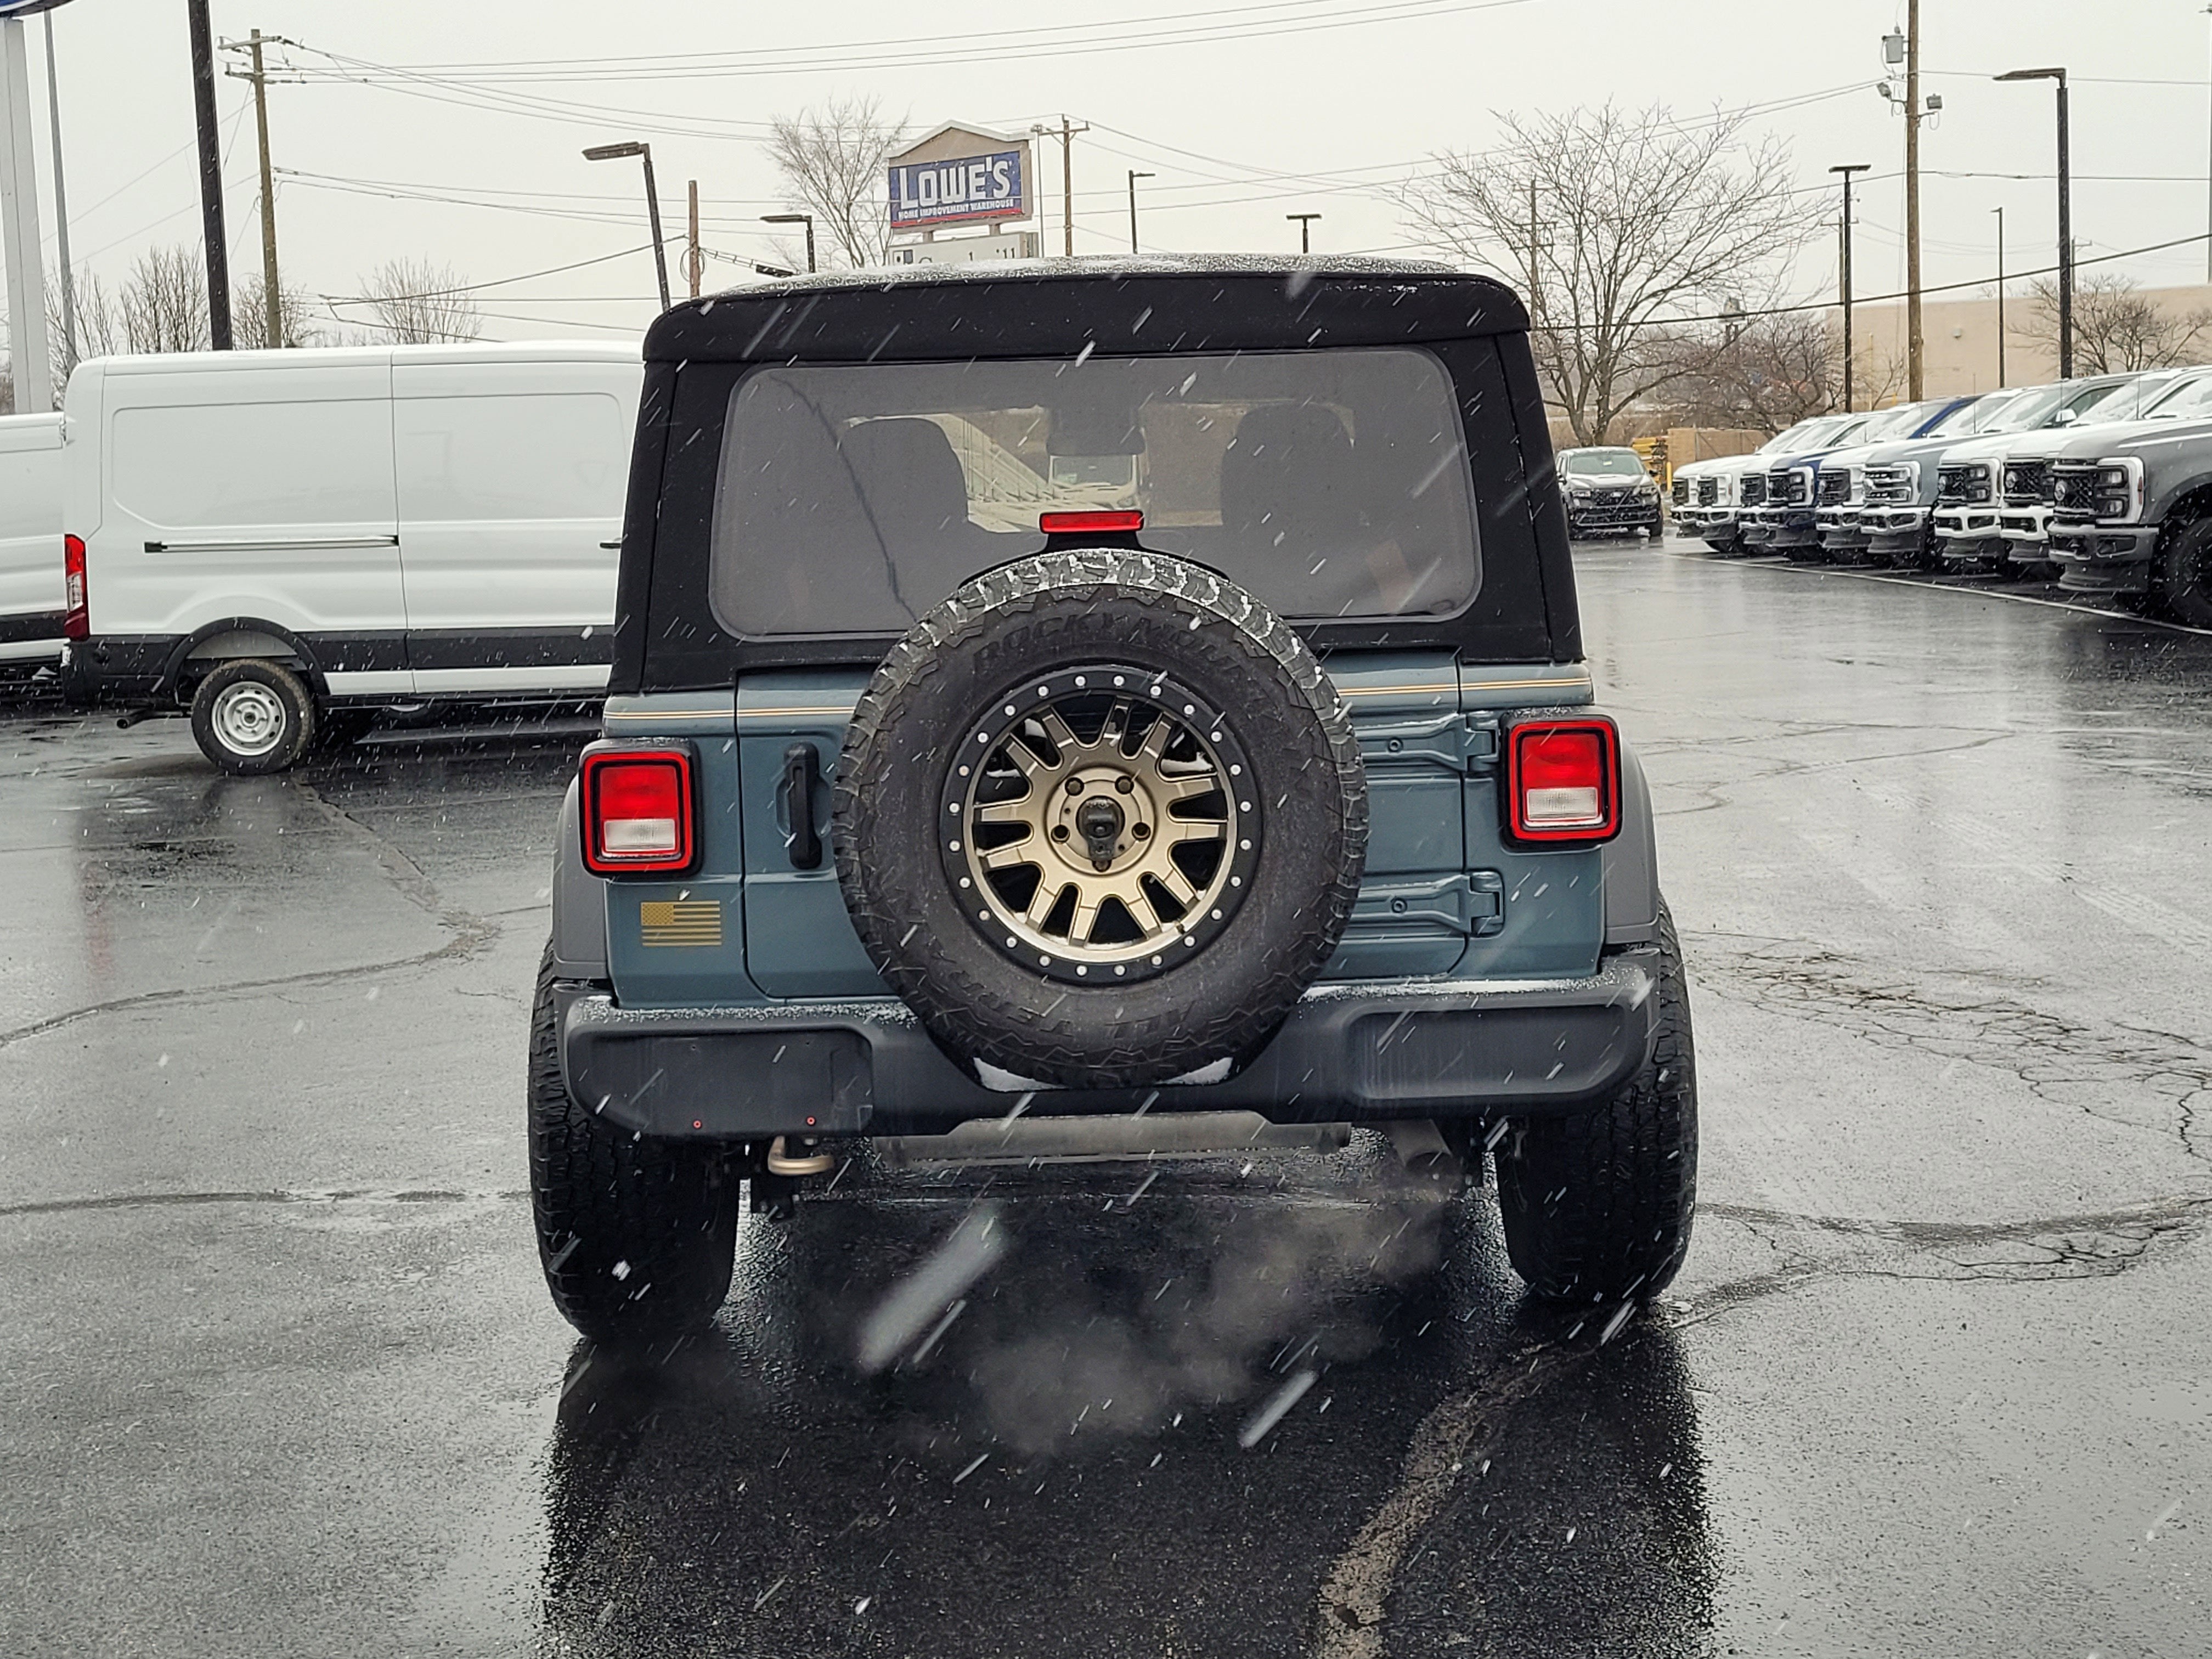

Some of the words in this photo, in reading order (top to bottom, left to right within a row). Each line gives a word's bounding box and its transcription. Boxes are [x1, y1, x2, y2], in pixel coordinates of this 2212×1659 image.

[898, 210, 918, 219] HOME
[919, 204, 969, 216] IMPROVEMENT
[970, 199, 1014, 211] WAREHOUSE
[899, 156, 1011, 209] LOWE'S
[972, 612, 1128, 673] ROCKY
